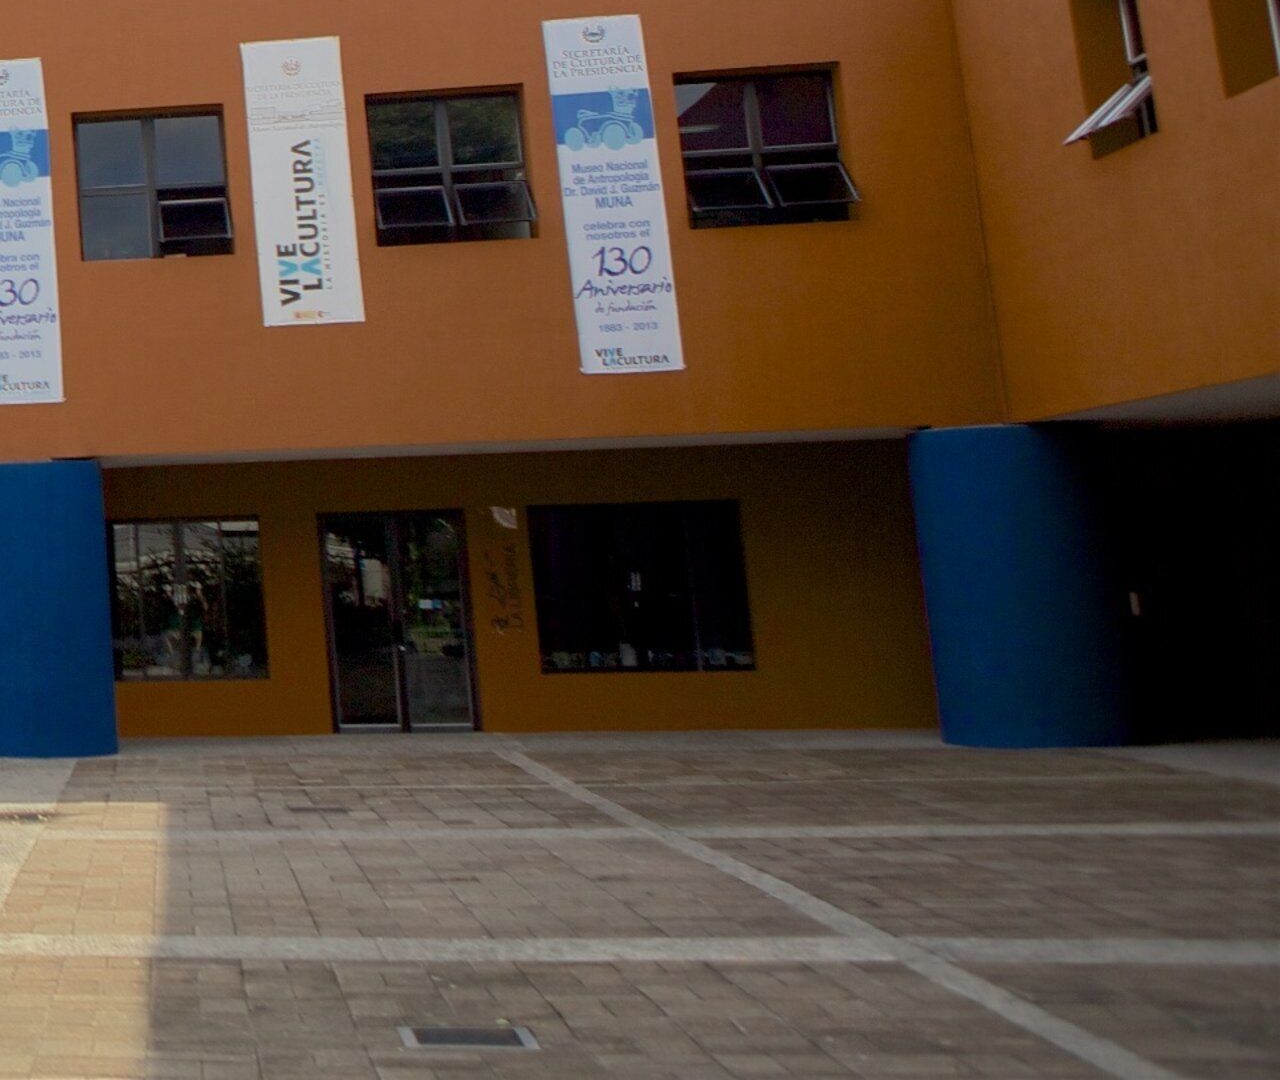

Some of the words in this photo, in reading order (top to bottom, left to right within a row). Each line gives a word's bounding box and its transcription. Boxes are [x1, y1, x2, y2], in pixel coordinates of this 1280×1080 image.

[570, 57, 623, 68] CULTURA
[554, 70, 568, 78] LA
[570, 65, 644, 77] PRESIDENCIA
[571, 163, 603, 173] Museo
[606, 160, 648, 171] Nacional
[573, 176, 585, 184] de
[588, 172, 649, 184] Antropología
[581, 185, 607, 195] David
[621, 183, 660, 192] Guzmán
[3, 197, 41, 207] Nacional
[595, 196, 633, 208] MUNA
[584, 221, 626, 231] celebra
[629, 220, 651, 228] con
[586, 231, 637, 240] nosotros
[20, 253, 40, 262] con
[592, 245, 652, 276] 130
[277, 244, 301, 306] VIVE
[575, 277, 672, 298] Aniversario
[595, 348, 622, 357] VIVE
